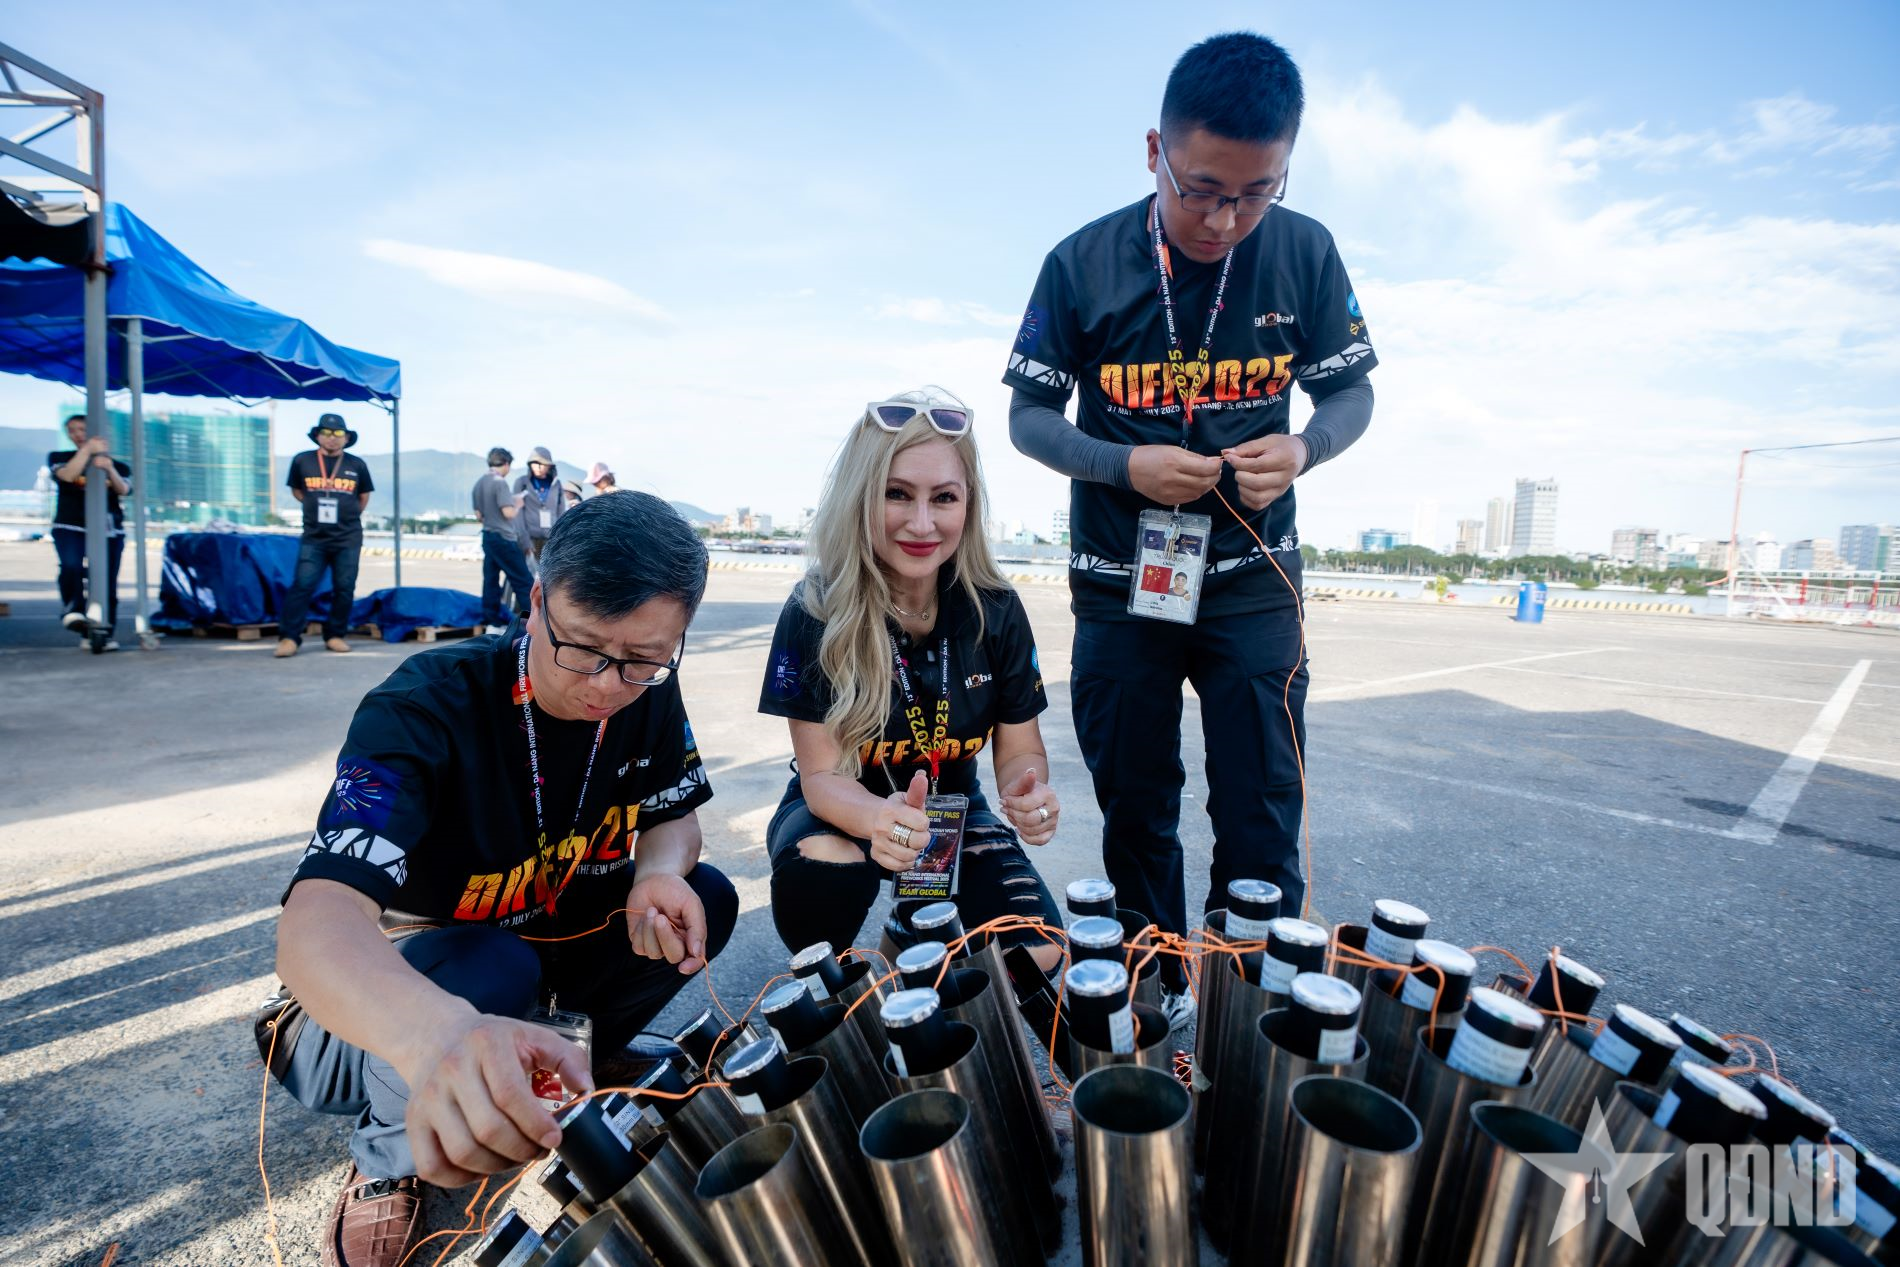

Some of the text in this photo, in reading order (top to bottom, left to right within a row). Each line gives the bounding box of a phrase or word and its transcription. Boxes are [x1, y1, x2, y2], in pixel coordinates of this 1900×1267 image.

[1160, 275, 1170, 295] NANG
[1217, 275, 1227, 295] NANG
[1164, 295, 1171, 305] DA
[1167, 349, 1189, 399] 2025
[1235, 401, 1251, 410] NEW
[1268, 394, 1283, 405] ERA
[518, 650, 527, 692] FIREWORKS
[521, 692, 537, 749] INTERNATIONAL
[905, 706, 933, 754] 2025
[530, 749, 539, 772] NANG
[533, 771, 539, 783] DA
[944, 811, 960, 819] PASS
[899, 888, 918, 896] TEAM
[510, 910, 531, 927] JULY
